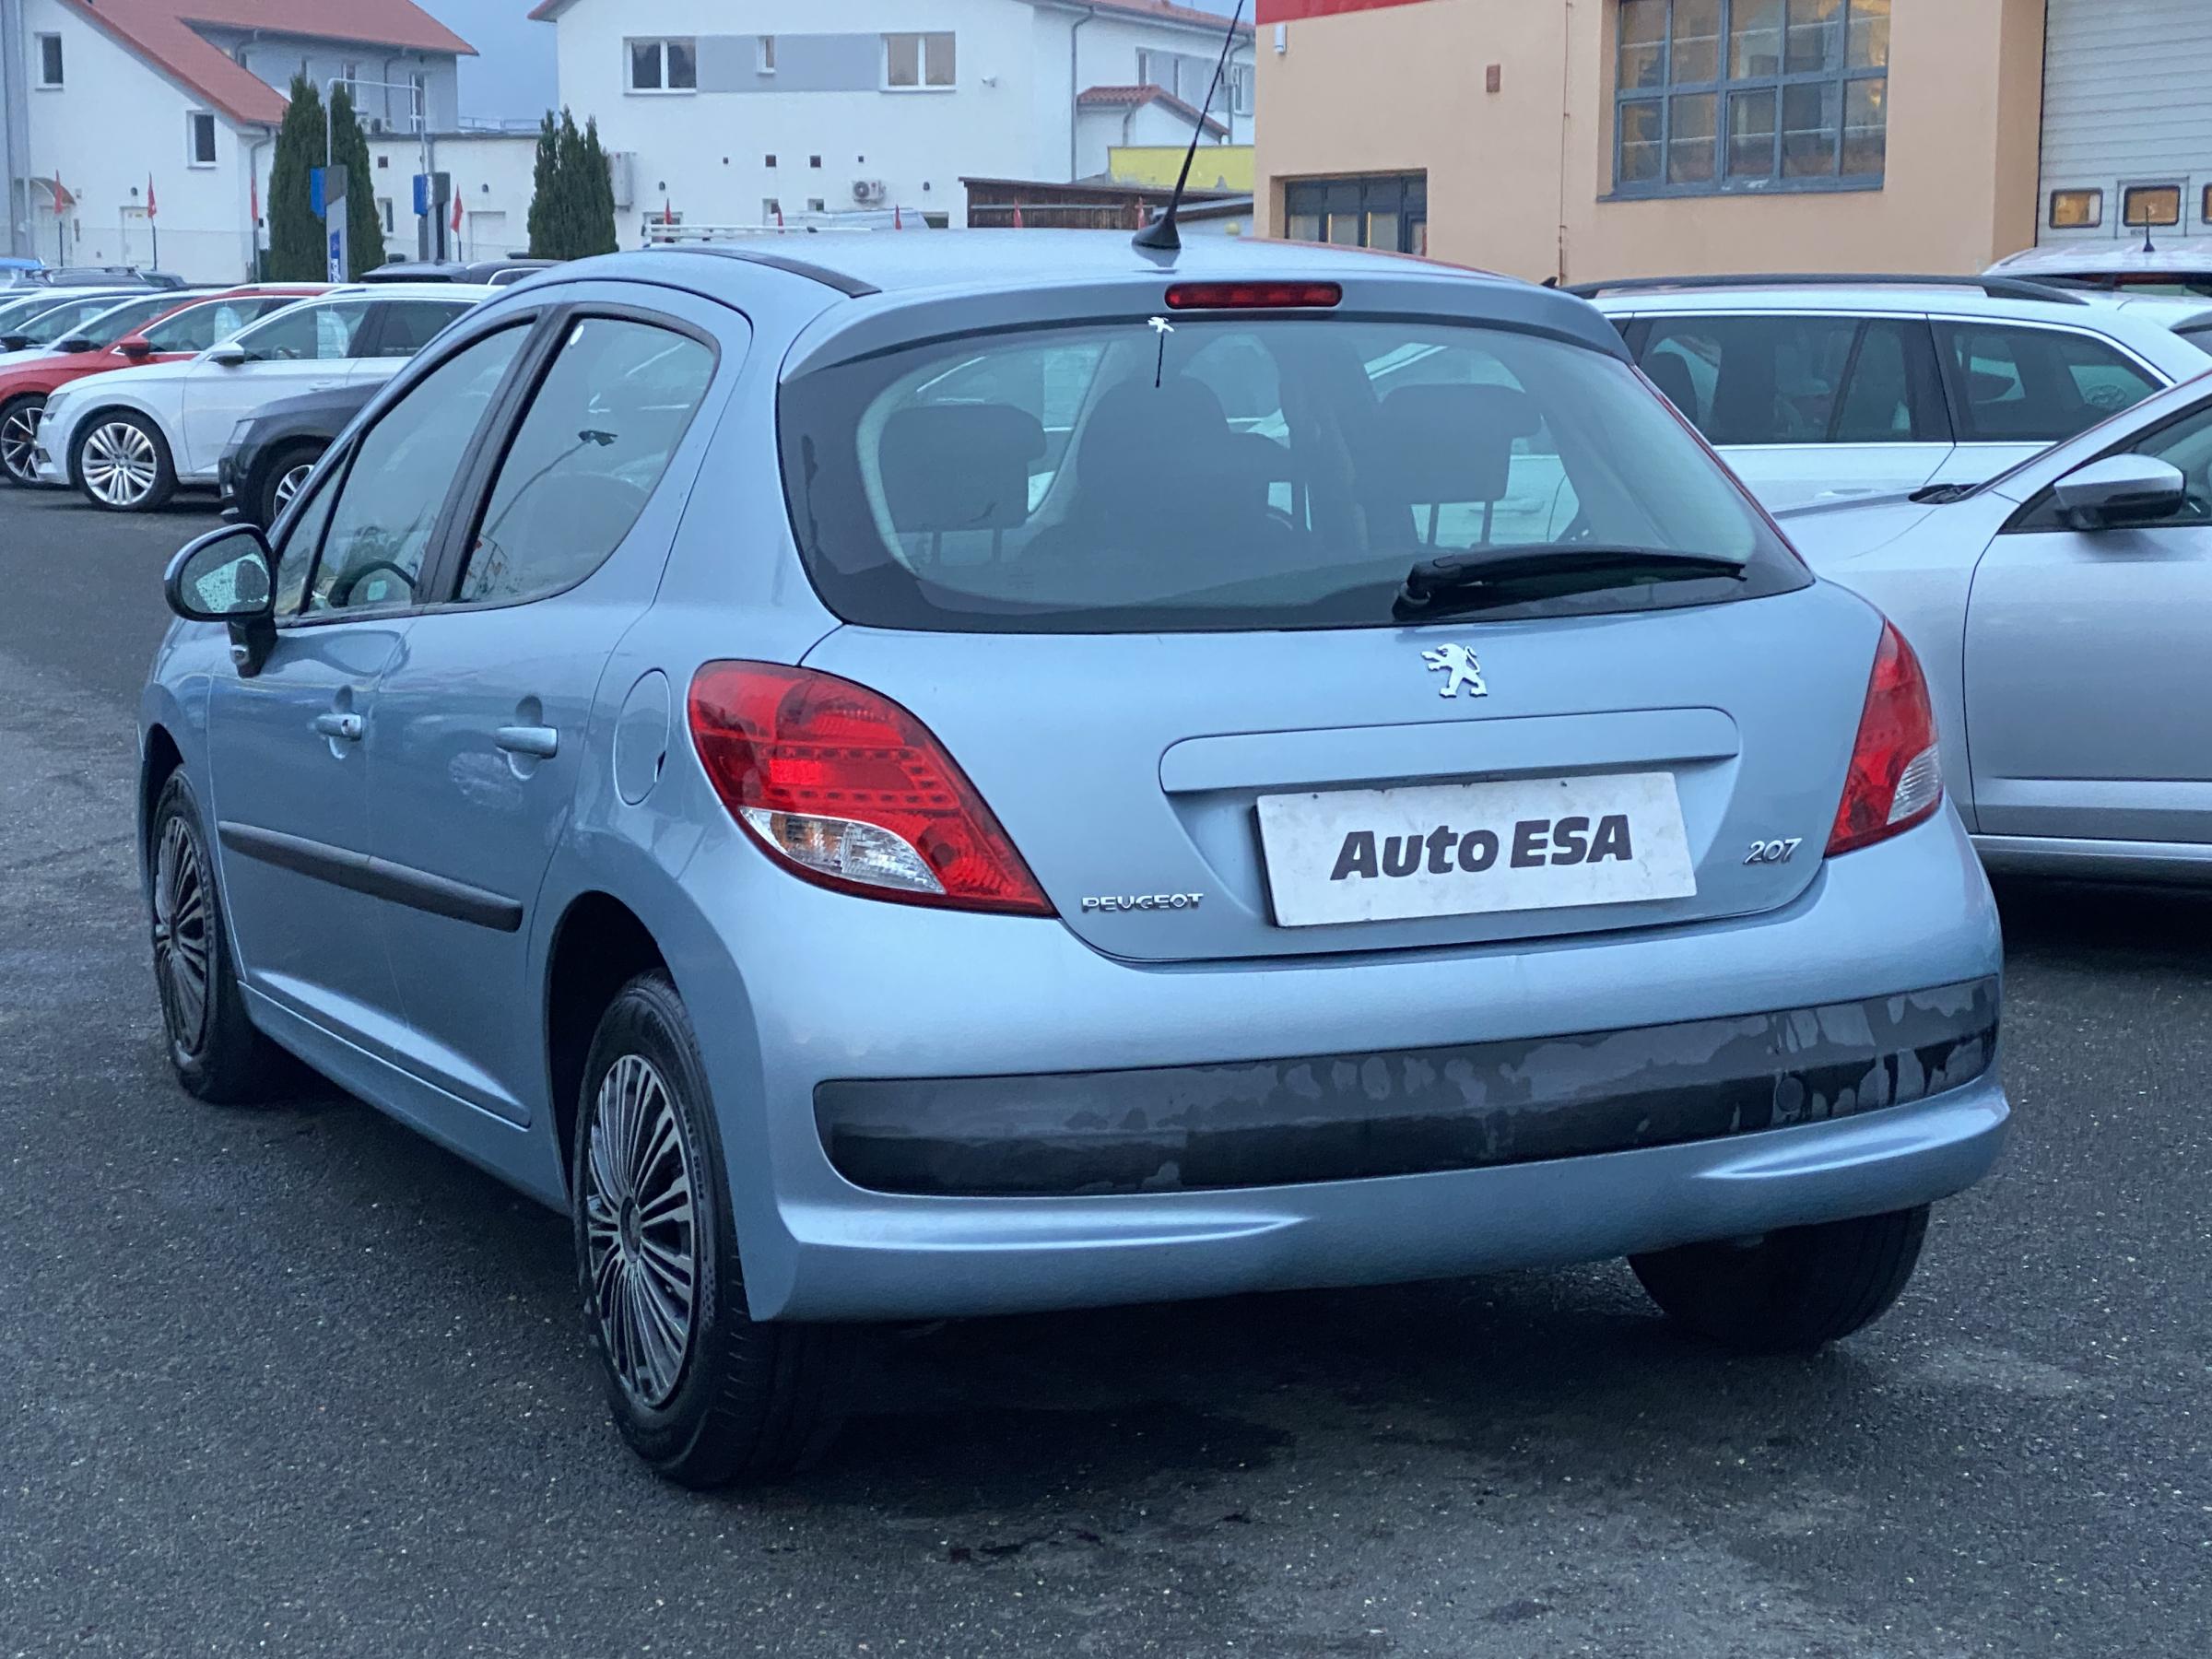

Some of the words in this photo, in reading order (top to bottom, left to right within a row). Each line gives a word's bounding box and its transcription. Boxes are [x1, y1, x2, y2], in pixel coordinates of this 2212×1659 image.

[1329, 825, 1500, 881] Auto
[1510, 814, 1633, 868] ESA
[1742, 837, 1803, 864] 207
[1081, 892, 1204, 912] PEUGEOT
